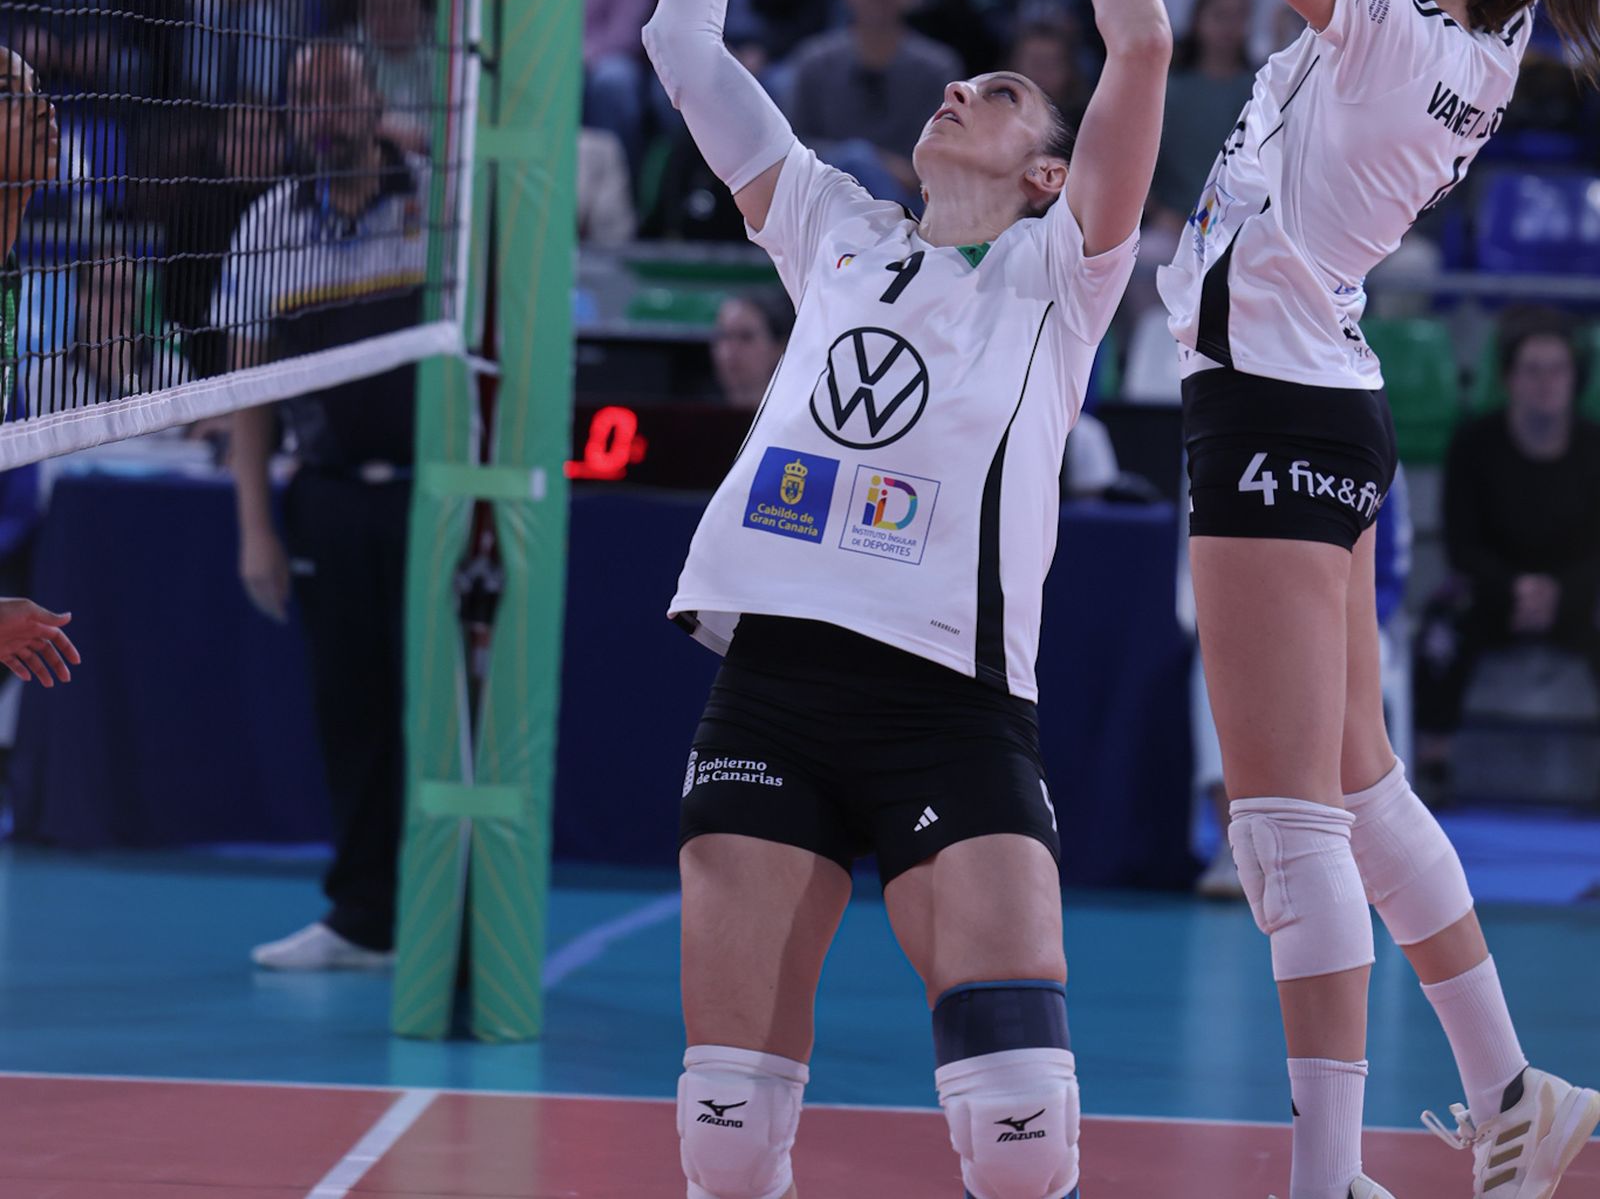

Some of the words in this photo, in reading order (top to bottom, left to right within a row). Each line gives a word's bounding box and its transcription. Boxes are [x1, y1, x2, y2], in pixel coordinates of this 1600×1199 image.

[1238, 452, 1278, 506] 4
[750, 512, 776, 528] Gran
[777, 518, 819, 537] Canaria
[757, 502, 799, 522] Cabildo
[799, 512, 815, 525] de
[862, 537, 912, 558] DEPORTES
[698, 757, 767, 773] Gobierno
[696, 772, 711, 785] de
[711, 770, 783, 787] Canarias
